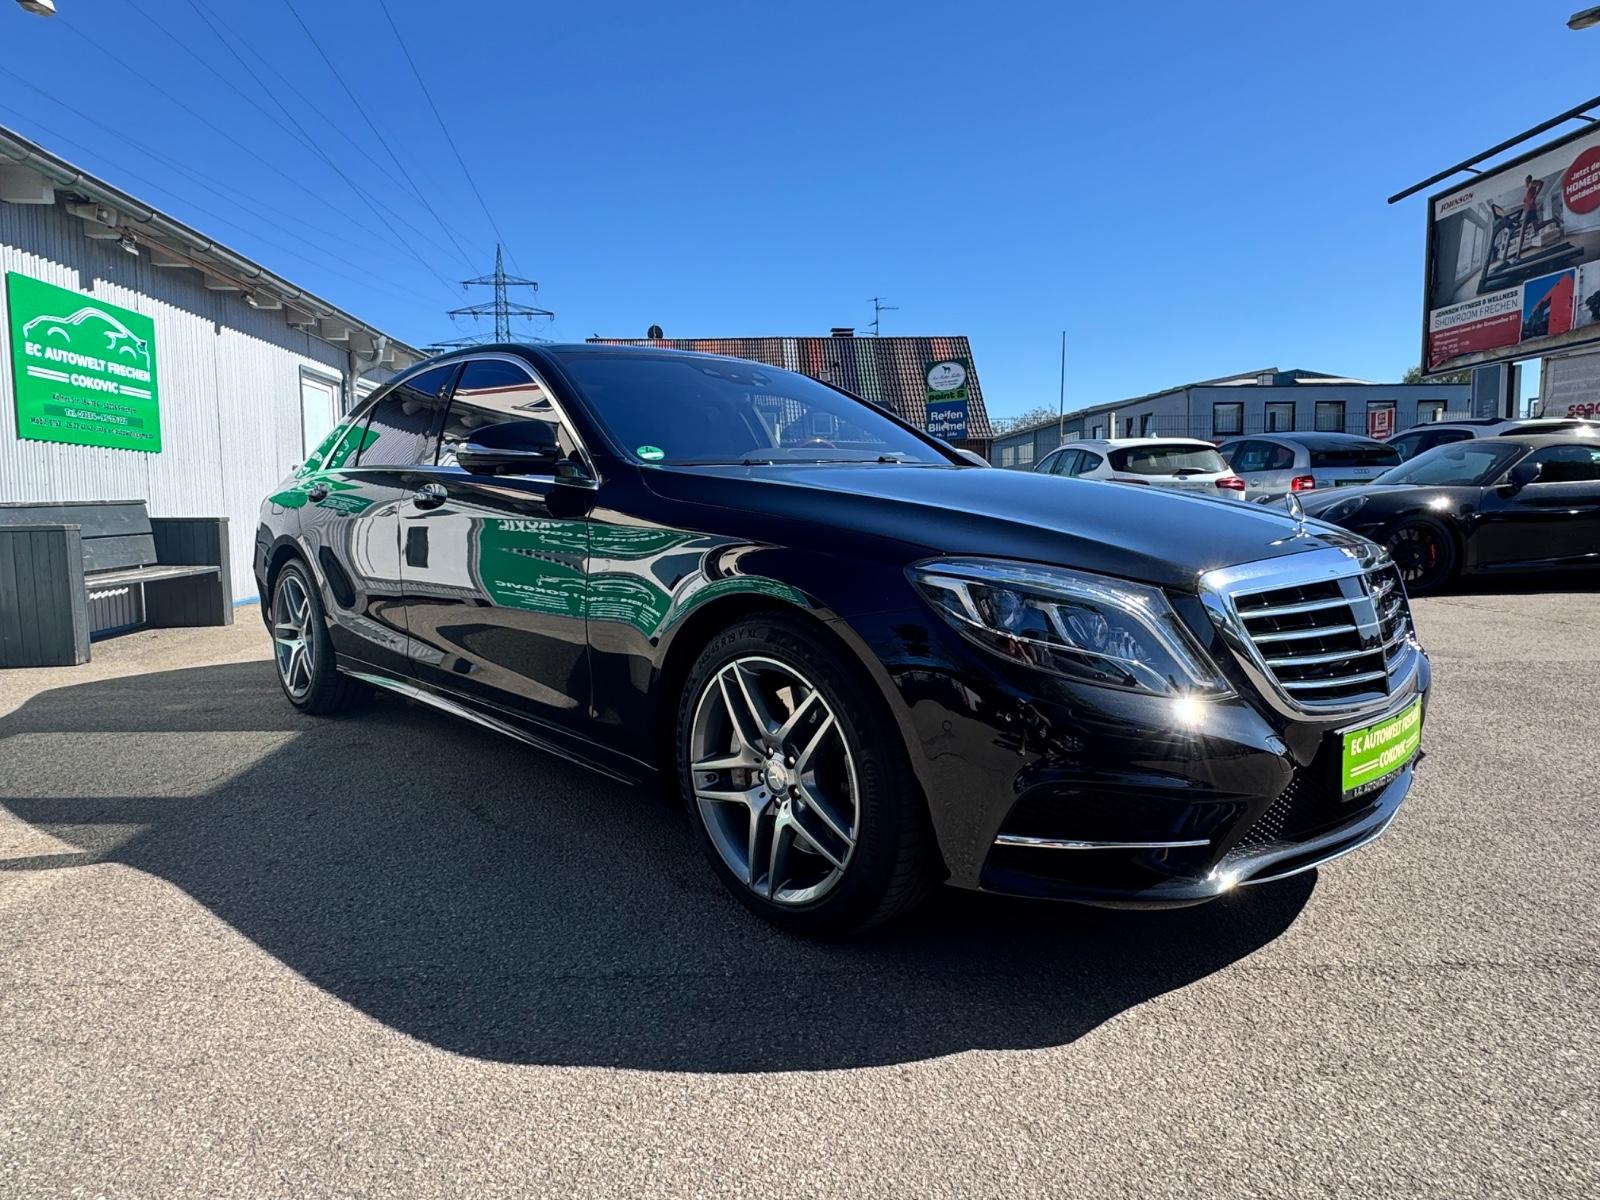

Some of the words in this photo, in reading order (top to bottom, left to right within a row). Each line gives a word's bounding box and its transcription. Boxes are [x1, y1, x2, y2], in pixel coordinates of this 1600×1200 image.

[1571, 166, 1590, 180] Jetzt
[1440, 191, 1475, 214] JOHNSON
[1434, 310, 1478, 329] SHOWROOM
[1480, 298, 1518, 316] FRECHEN
[1435, 305, 1459, 318] JOHNSON
[1460, 299, 1481, 312] FITNESS
[1487, 289, 1519, 304] WELLNESS
[25, 342, 42, 357] EC
[45, 347, 107, 373] AUTOWELT
[108, 361, 151, 383] FRECHEN
[71, 373, 119, 394] COKOVIC
[928, 391, 955, 402] point
[957, 389, 965, 398] S
[930, 410, 963, 421] Reifen
[1351, 736, 1363, 756] EC
[1363, 719, 1401, 751] AUTOWELT
[1379, 739, 1406, 768] COKOVIC
